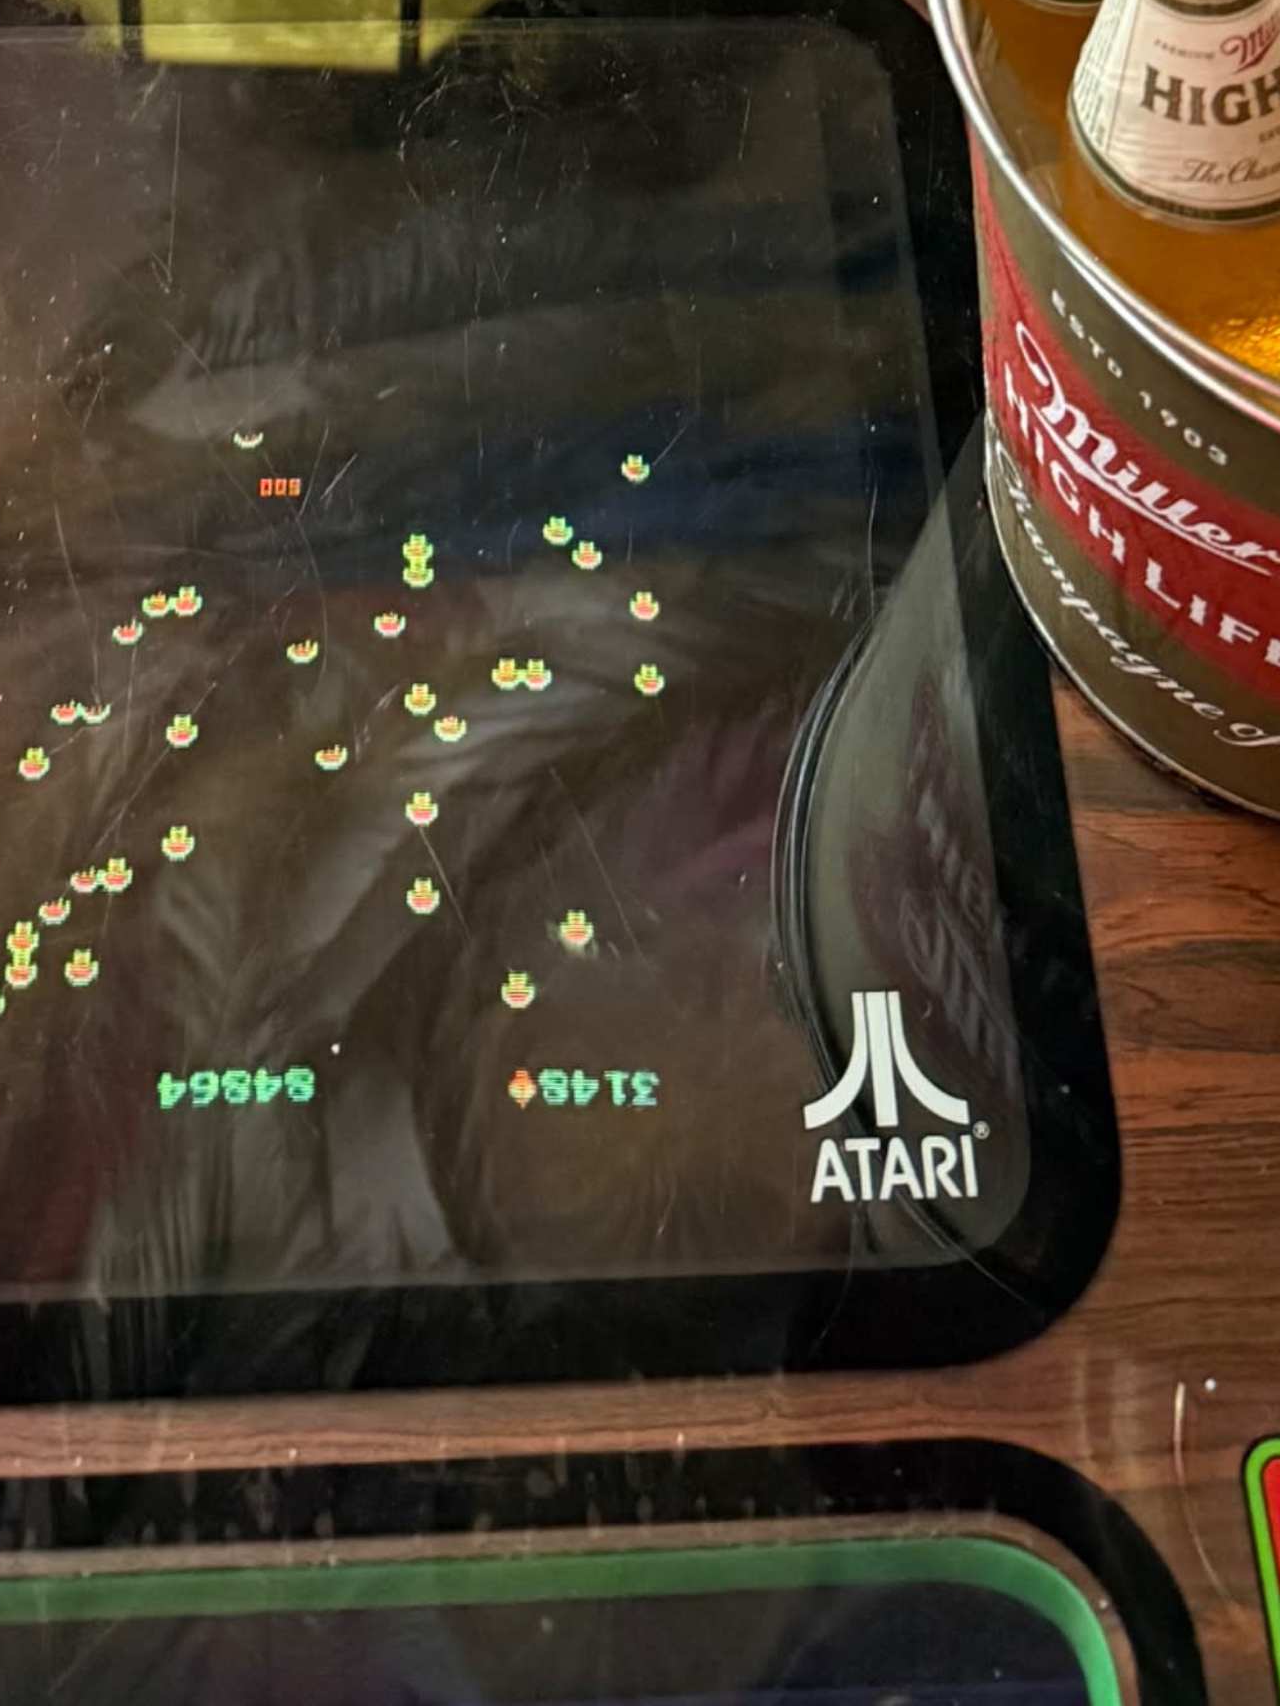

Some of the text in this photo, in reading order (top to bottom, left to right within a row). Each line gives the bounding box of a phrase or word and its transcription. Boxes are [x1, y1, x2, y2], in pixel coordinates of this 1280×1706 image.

[1004, 361, 1125, 565] HIGH
[1139, 390, 1228, 467] 1903
[995, 440, 1224, 721] Champagne
[157, 1066, 316, 1109] 84864
[538, 1070, 660, 1107] 3148
[810, 1134, 979, 1204] ATARI
